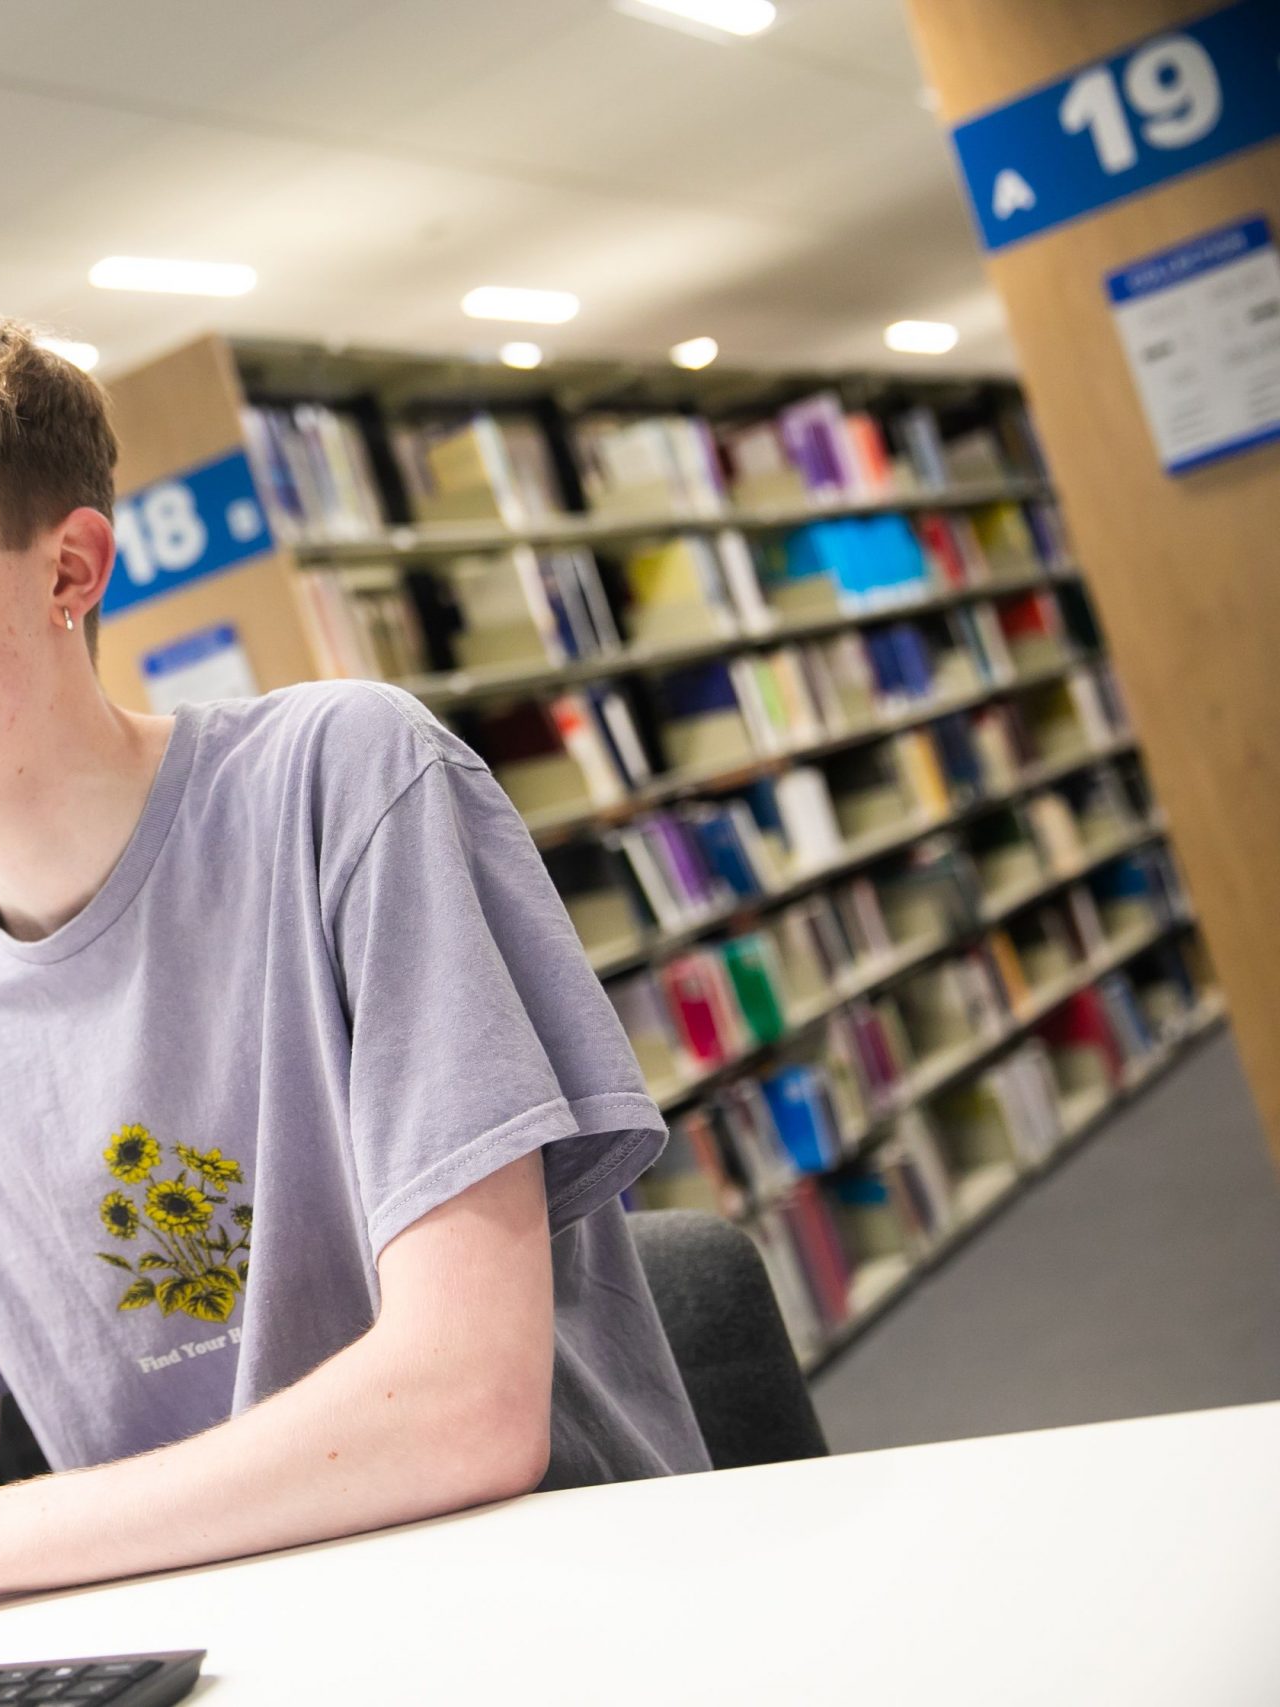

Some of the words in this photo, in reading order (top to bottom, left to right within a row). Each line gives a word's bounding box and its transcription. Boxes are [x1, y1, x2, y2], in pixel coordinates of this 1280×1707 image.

[992, 168, 1036, 220] A
[1059, 31, 1223, 176] 19
[112, 482, 208, 586] 18
[137, 1350, 183, 1373] Find
[180, 1336, 227, 1358] Your
